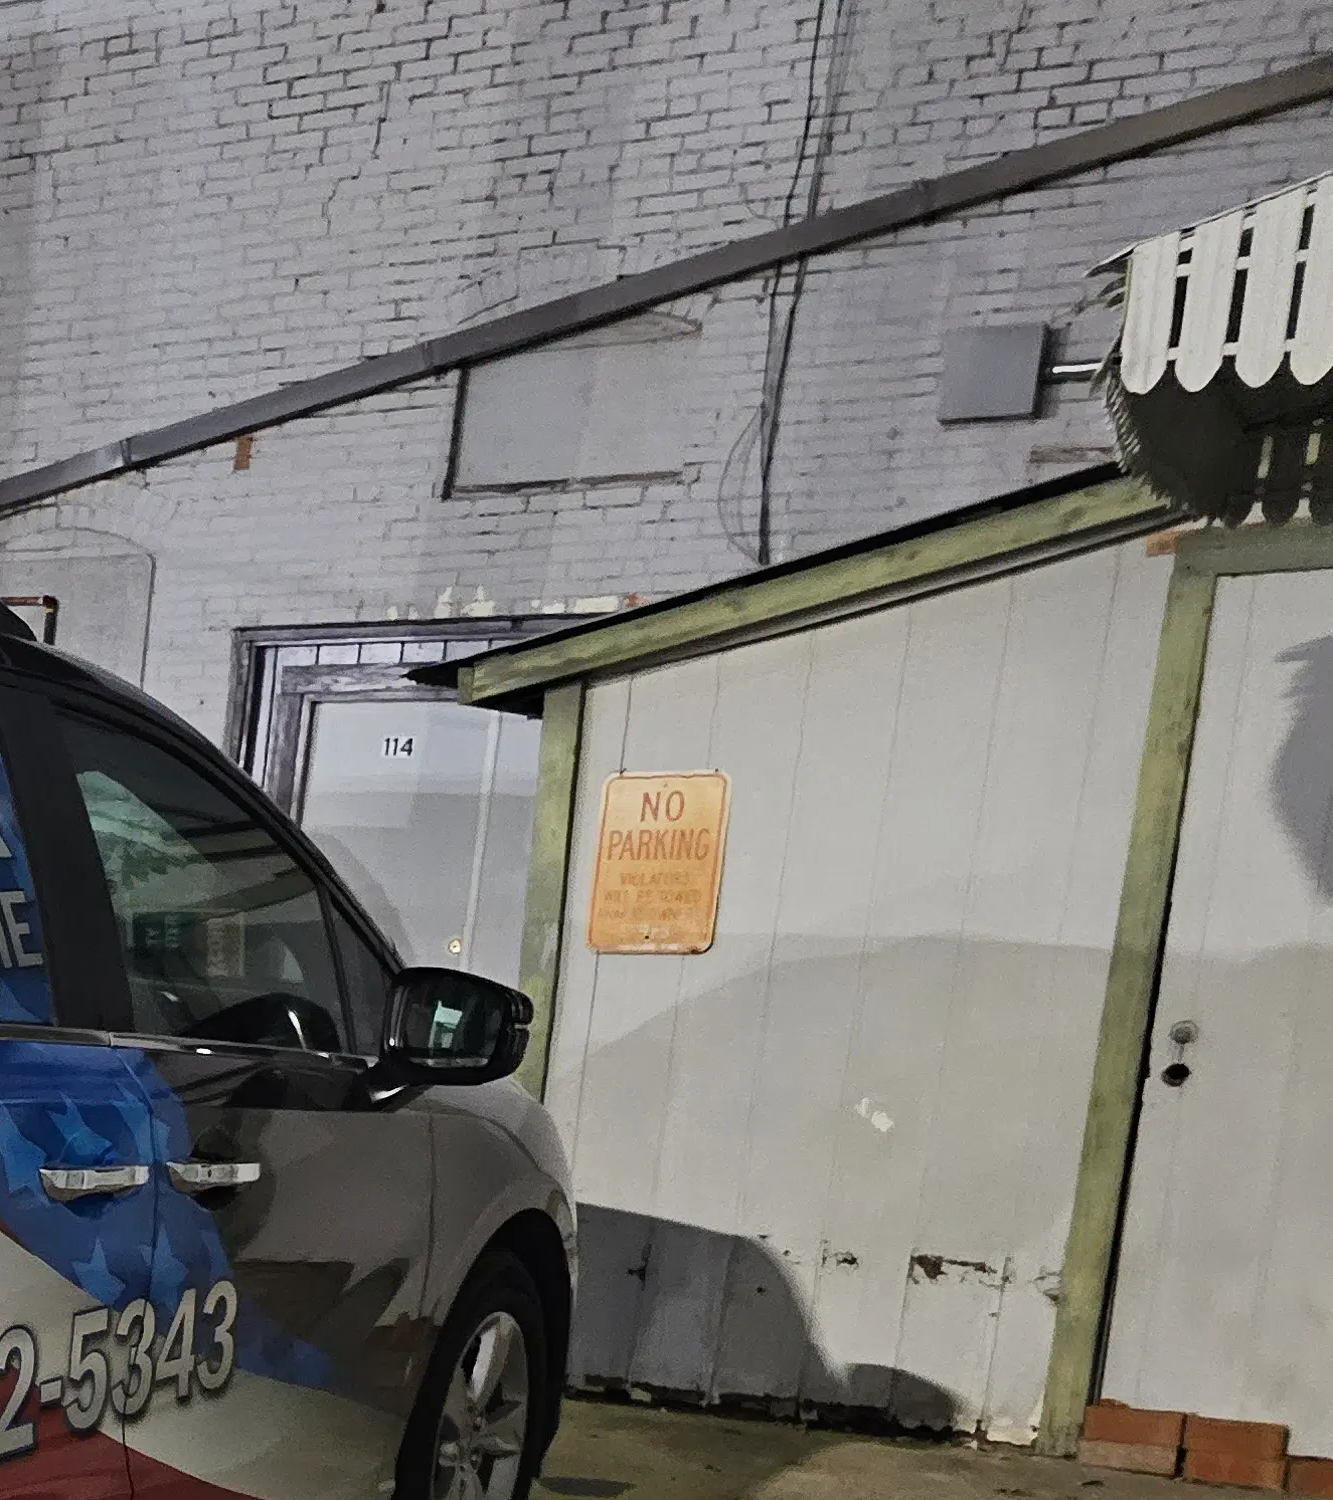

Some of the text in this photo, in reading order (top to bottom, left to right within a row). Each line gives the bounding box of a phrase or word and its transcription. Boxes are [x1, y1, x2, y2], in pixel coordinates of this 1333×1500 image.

[383, 737, 414, 756] 114
[640, 790, 685, 822] NO
[607, 828, 711, 861] PARKING
